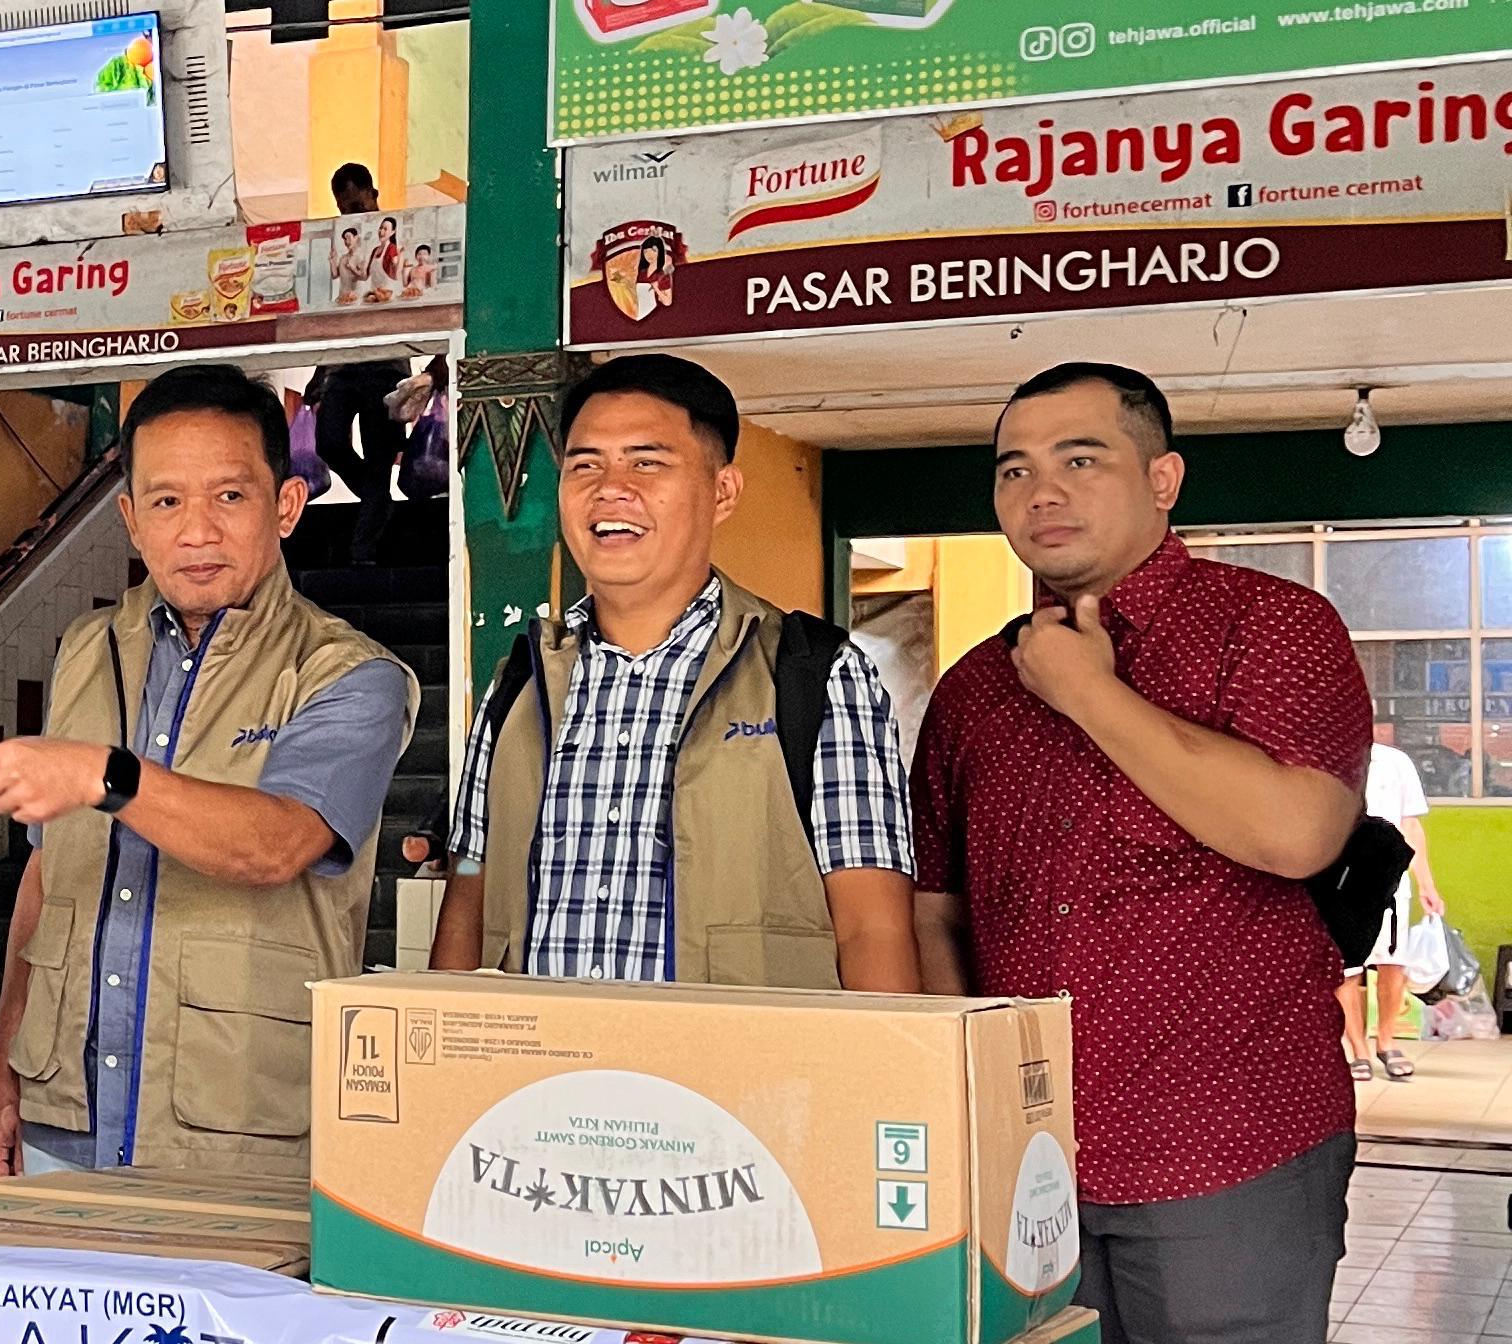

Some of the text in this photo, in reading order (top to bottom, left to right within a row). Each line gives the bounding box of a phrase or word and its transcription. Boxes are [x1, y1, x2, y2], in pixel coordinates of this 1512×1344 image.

[1108, 16, 1256, 46] tehjawa.official
[593, 118, 1241, 198] wilmar Fortune Rajanya
[1062, 175, 1423, 219] fortunecermat fortune cermat
[12, 255, 129, 297] Garing
[746, 237, 1281, 315] PASAR BERINGHARJO
[27, 331, 180, 362] BERINGHARJO
[103, 1288, 186, 1323] (MGR)
